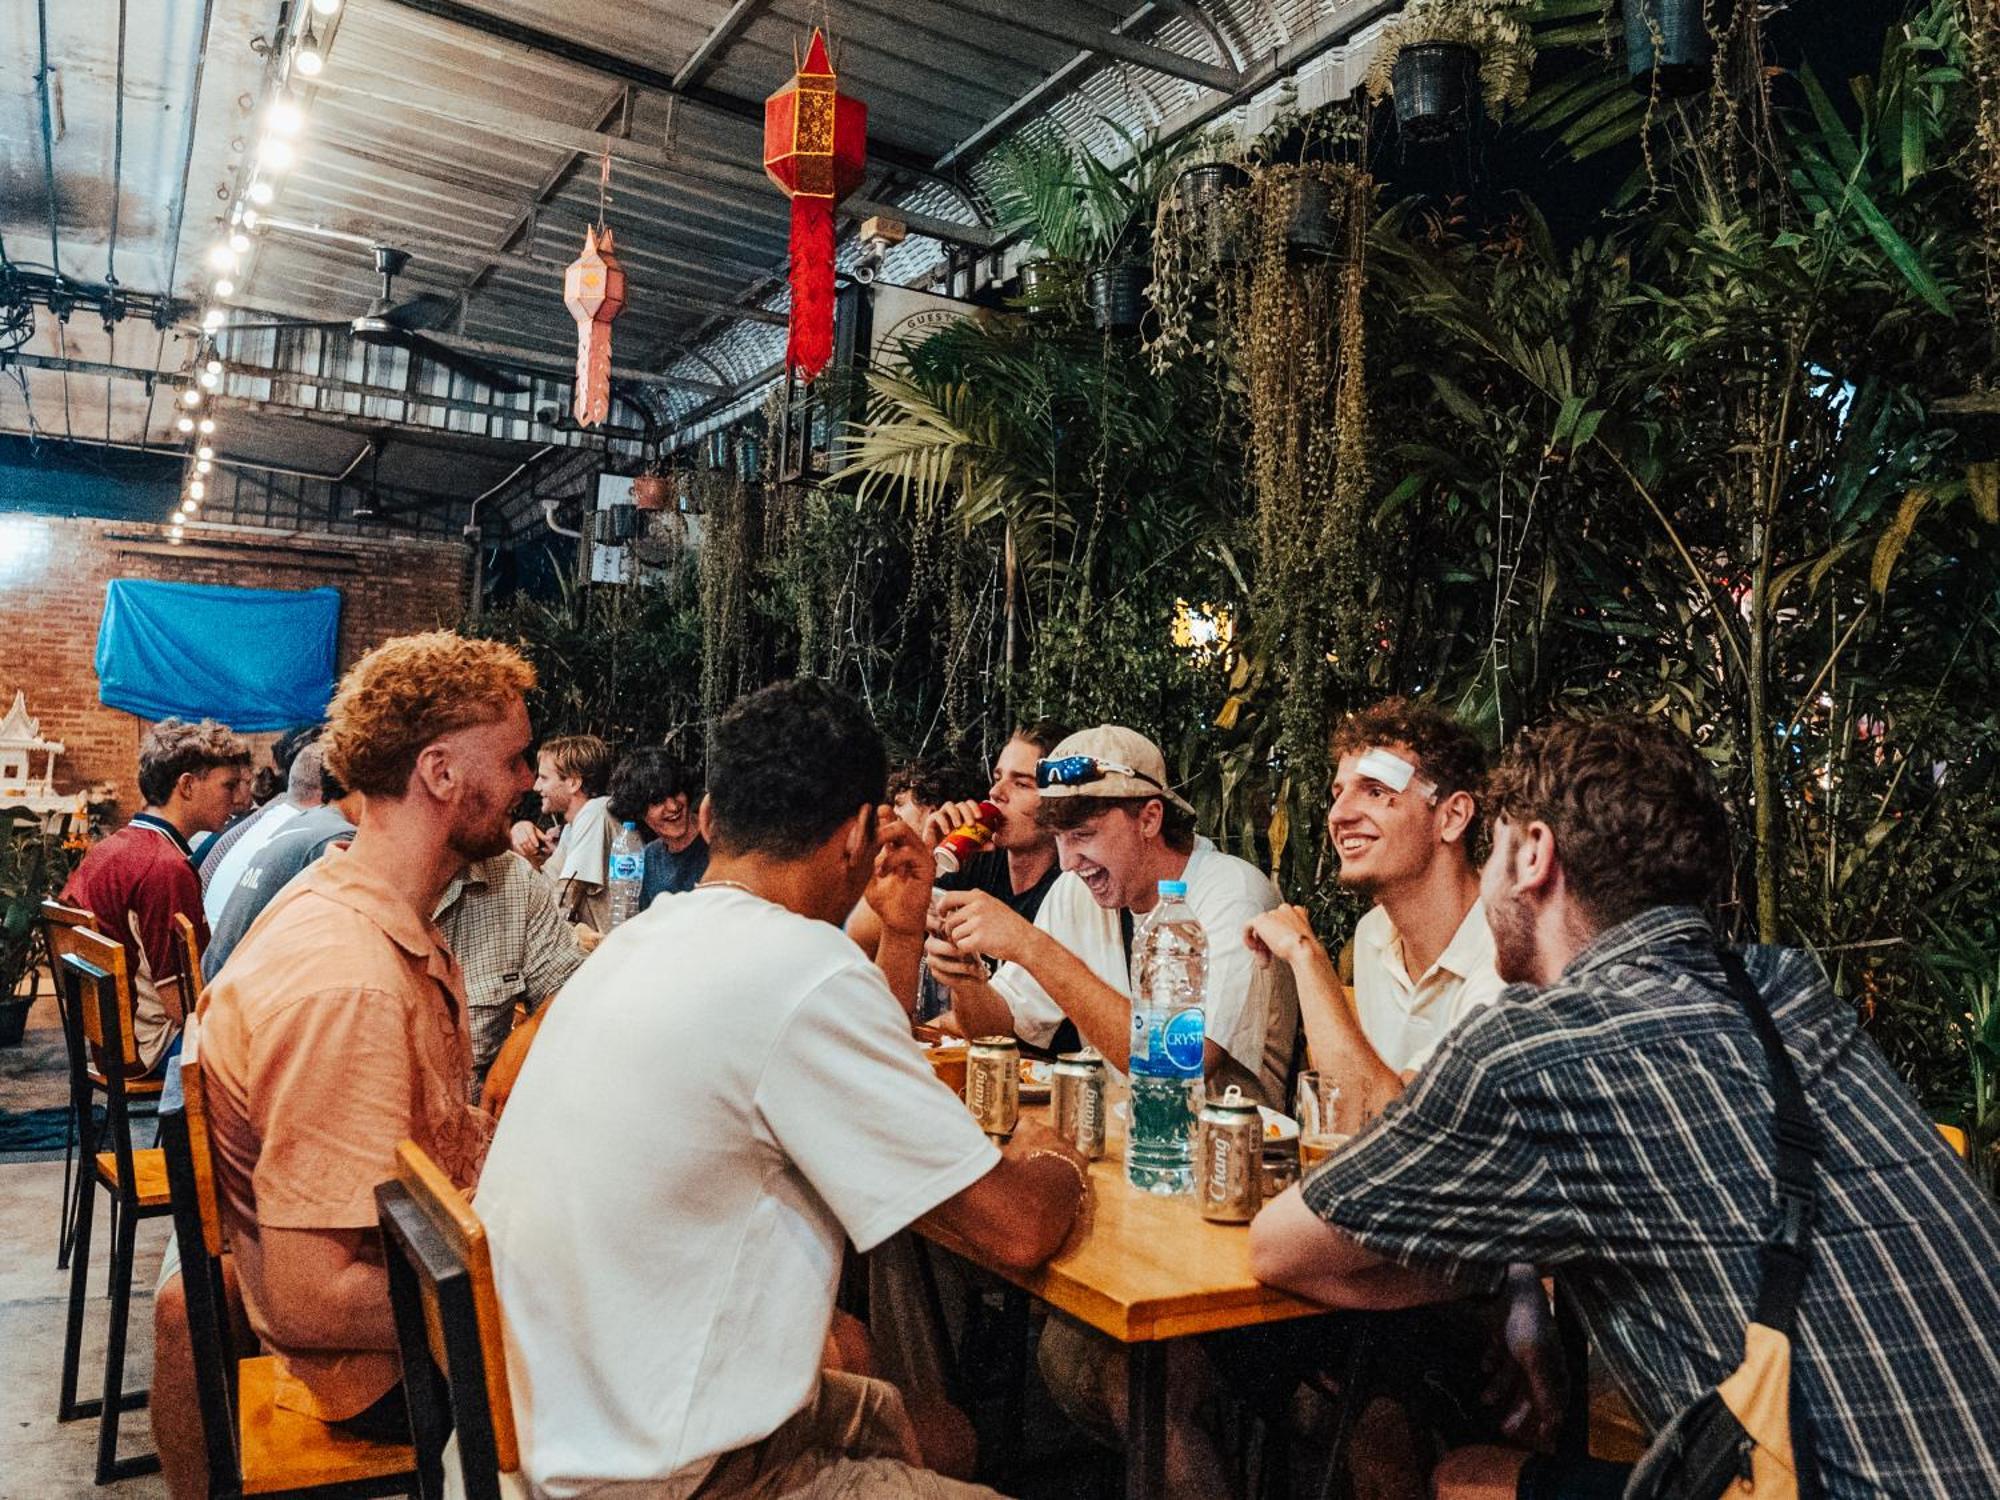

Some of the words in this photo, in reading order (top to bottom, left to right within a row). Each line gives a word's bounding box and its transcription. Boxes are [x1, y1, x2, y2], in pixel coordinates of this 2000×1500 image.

[969, 1069, 988, 1119] Chang
[1080, 1088, 1098, 1141] Chang
[1208, 1137, 1231, 1201] Chang
